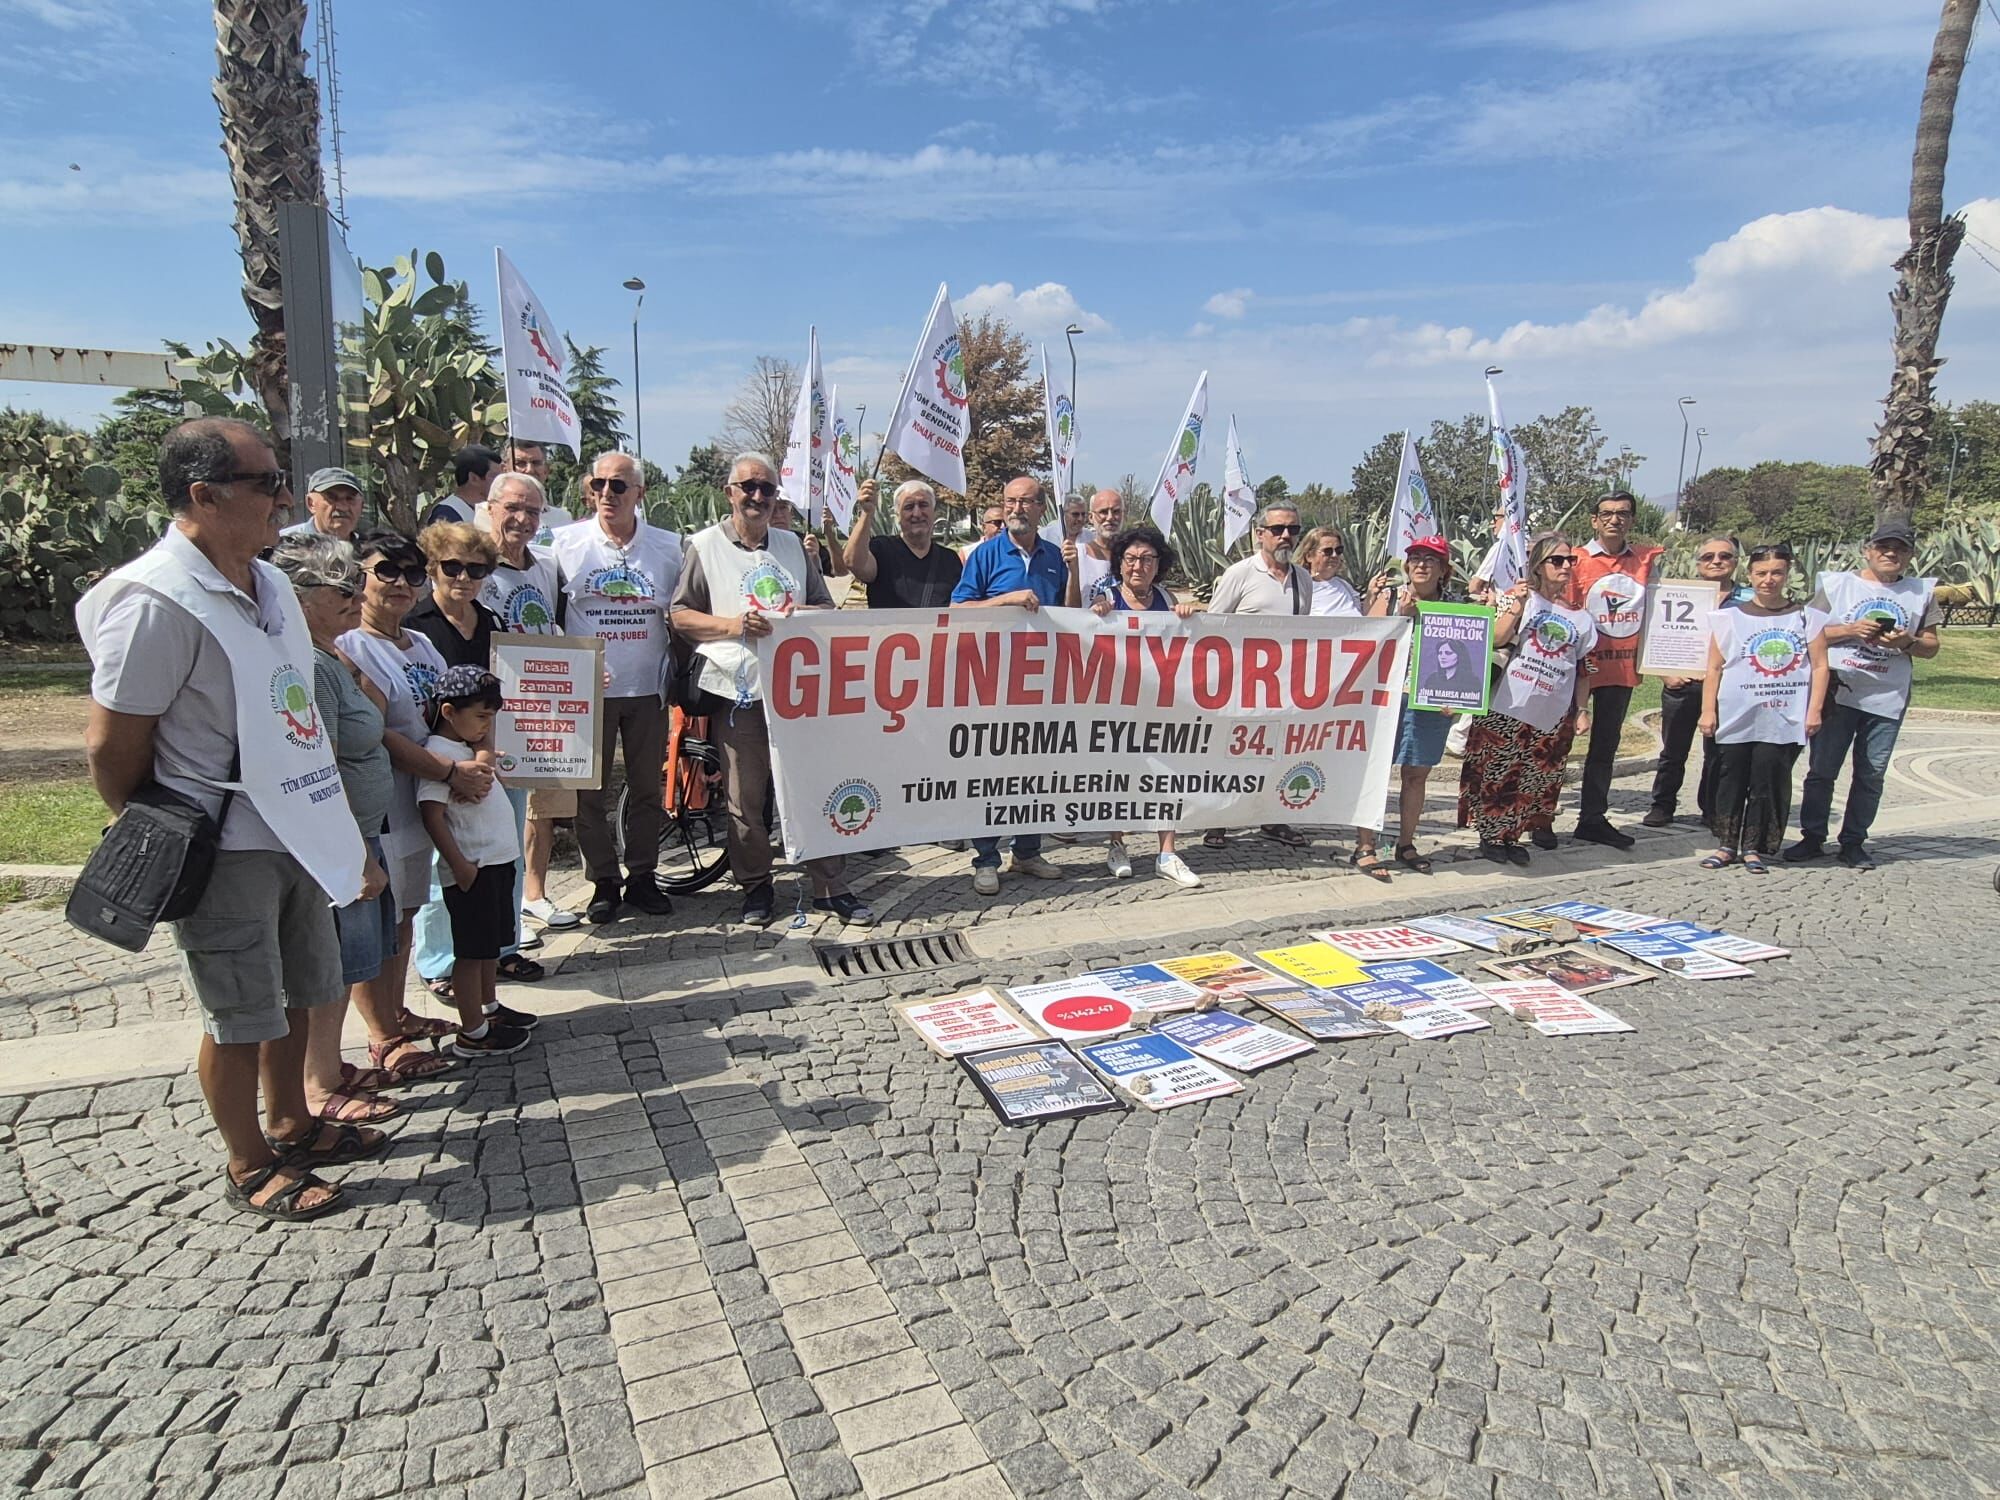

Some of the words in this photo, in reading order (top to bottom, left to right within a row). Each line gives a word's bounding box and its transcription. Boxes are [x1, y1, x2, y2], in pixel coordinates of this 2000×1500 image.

[517, 368, 541, 380] TÜM
[914, 390, 929, 406] TÜM
[585, 608, 602, 617] TÜM
[604, 608, 657, 617] EMEKLİLERİN
[1662, 600, 1695, 623] 12
[599, 617, 646, 625] SENDİKASI
[1424, 616, 1453, 626] KADIN
[1454, 618, 1485, 630] YAŞAM
[621, 629, 648, 642] ŞUBESİ
[1424, 625, 1484, 641] ÖZGÜRLÜK
[525, 661, 569, 673] Müsait
[772, 614, 1397, 733] GEÇİNEMİYORUZ!
[1511, 670, 1535, 682] KONAK
[520, 681, 571, 693] zaman:
[1418, 687, 1434, 697] JİNA
[1435, 690, 1460, 699] MAHSA
[1754, 689, 1797, 697] SENDİKASI
[559, 703, 587, 713] var,
[515, 720, 575, 733] emekliye
[949, 721, 1077, 758] OTURMA
[1089, 716, 1212, 753] EYLEMİ!
[1230, 725, 1274, 755] 34.
[1284, 720, 1367, 755] HAFTA
[538, 756, 587, 764] EMEKLİLERİN
[281, 777, 300, 795] TÜM
[902, 777, 957, 803] TÜM
[967, 770, 1128, 799] EMEKLİLERİN
[1139, 770, 1265, 794] SENDİKASI
[985, 799, 1056, 826] İZMİR
[1065, 799, 1183, 827] ŞUBELERİ
[1329, 928, 1421, 942] ARTIK
[1341, 936, 1444, 950] YETER
[1092, 1042, 1142, 1057] EMEKLİYE
[1160, 1063, 1199, 1078] yağma
[1170, 1071, 1209, 1084] düzeni
[1170, 1077, 1222, 1093] yıkılacak
